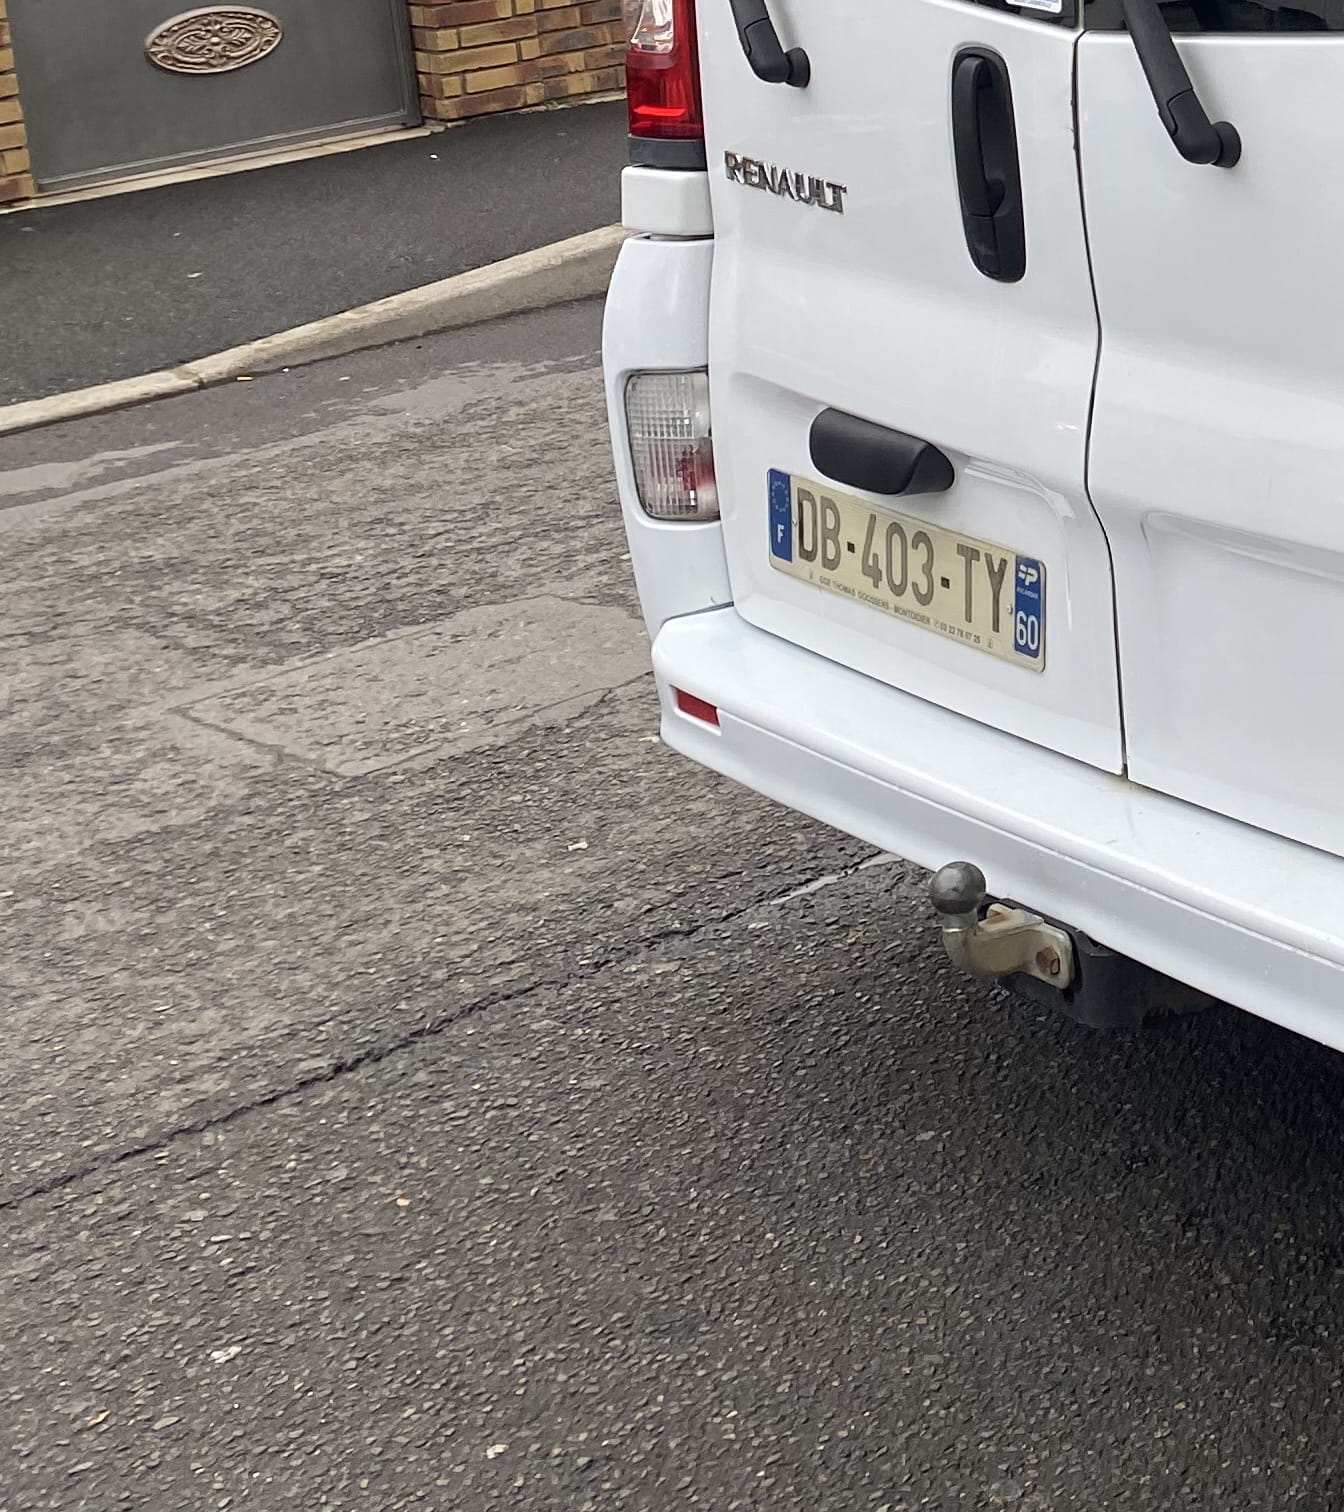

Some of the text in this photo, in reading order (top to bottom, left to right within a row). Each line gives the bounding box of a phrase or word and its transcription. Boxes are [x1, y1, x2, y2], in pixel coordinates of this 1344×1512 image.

[725, 150, 847, 215] RENAULT
[776, 523, 785, 543] F
[796, 486, 1008, 634] DB-403-TY
[1015, 609, 1039, 651] 60
